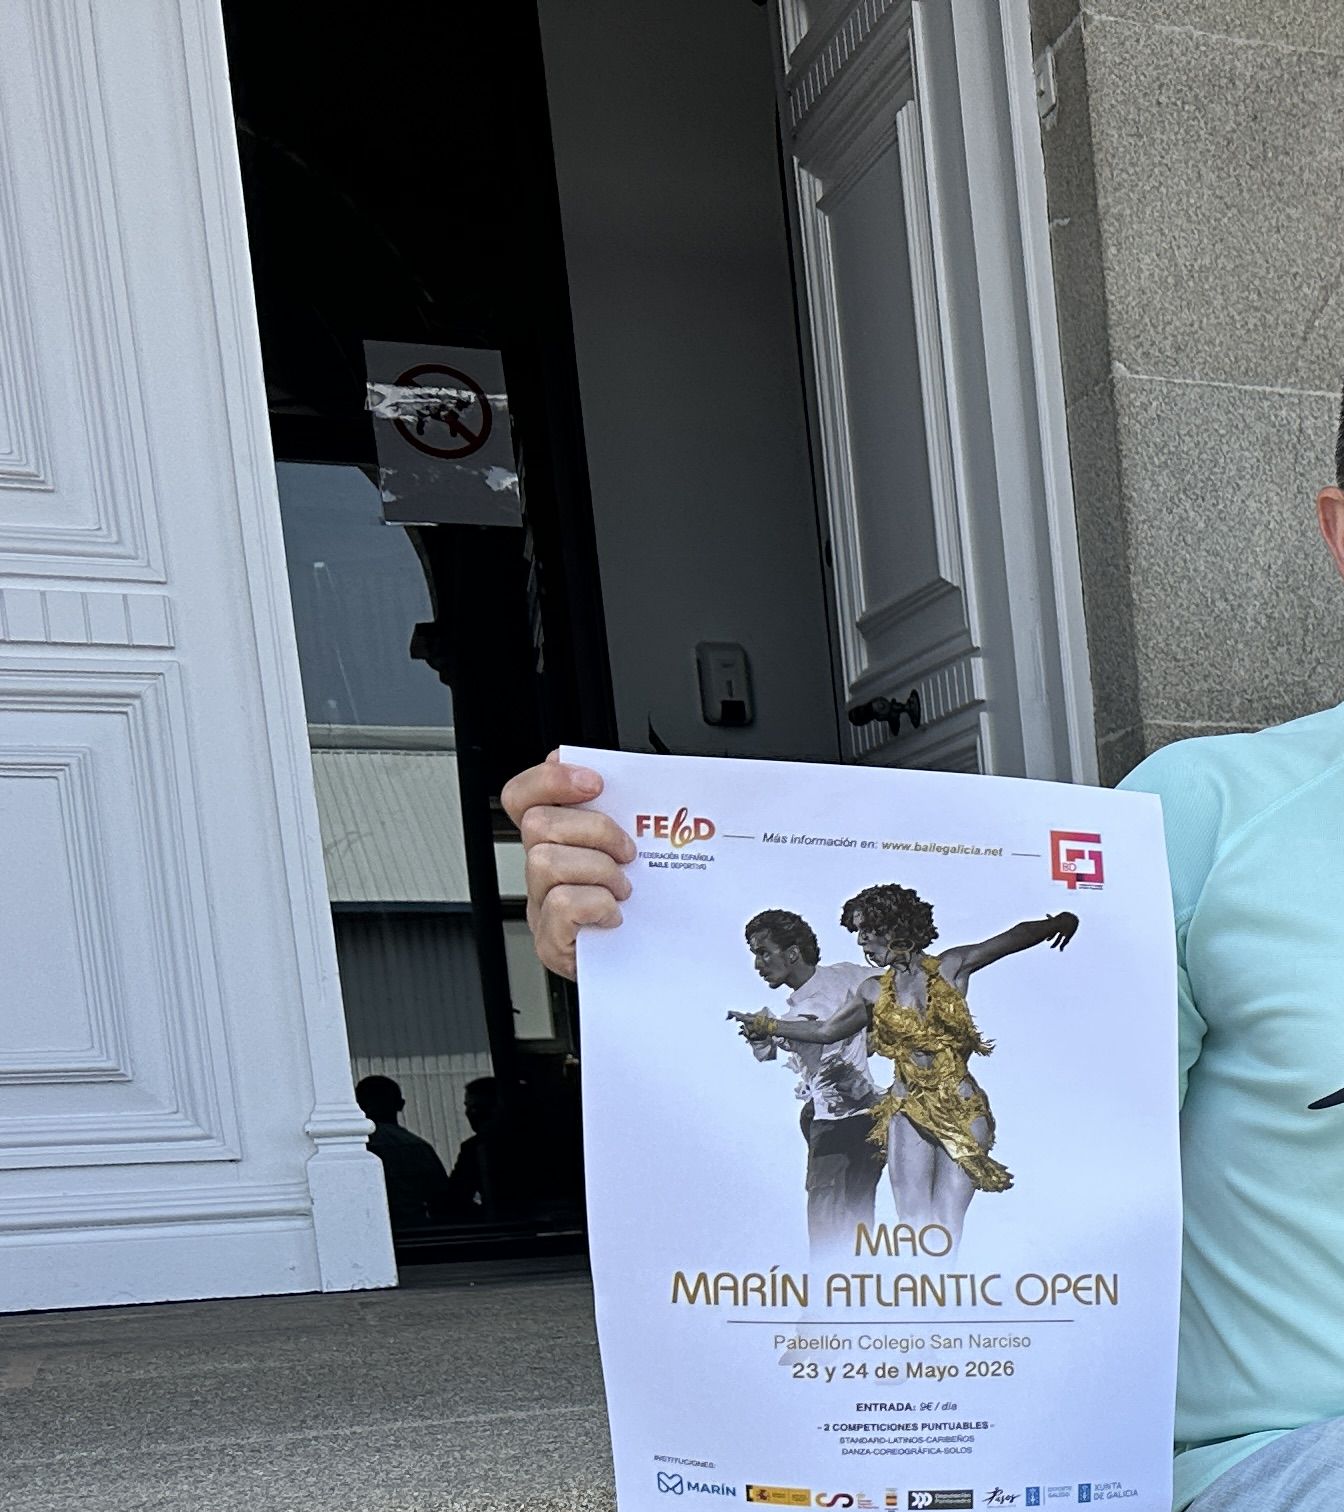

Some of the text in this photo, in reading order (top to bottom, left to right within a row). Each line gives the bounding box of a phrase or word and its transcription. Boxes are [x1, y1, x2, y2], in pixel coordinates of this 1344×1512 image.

[762, 832, 788, 844] Más
[790, 834, 857, 848] información
[881, 840, 1003, 857] www.bailegalicia.net
[855, 1222, 953, 1257] MAO
[671, 1264, 1118, 1307] MARÍN ATLANTIC OPEN
[774, 1333, 1031, 1353] Pabellón Colegio San Narciso
[792, 1360, 1015, 1383] 23 y 24 de Mayo 2026
[856, 1402, 917, 1412] ENTRADA:
[832, 1423, 918, 1432] COMPETICIONES
[687, 1481, 737, 1497] MARÍN
